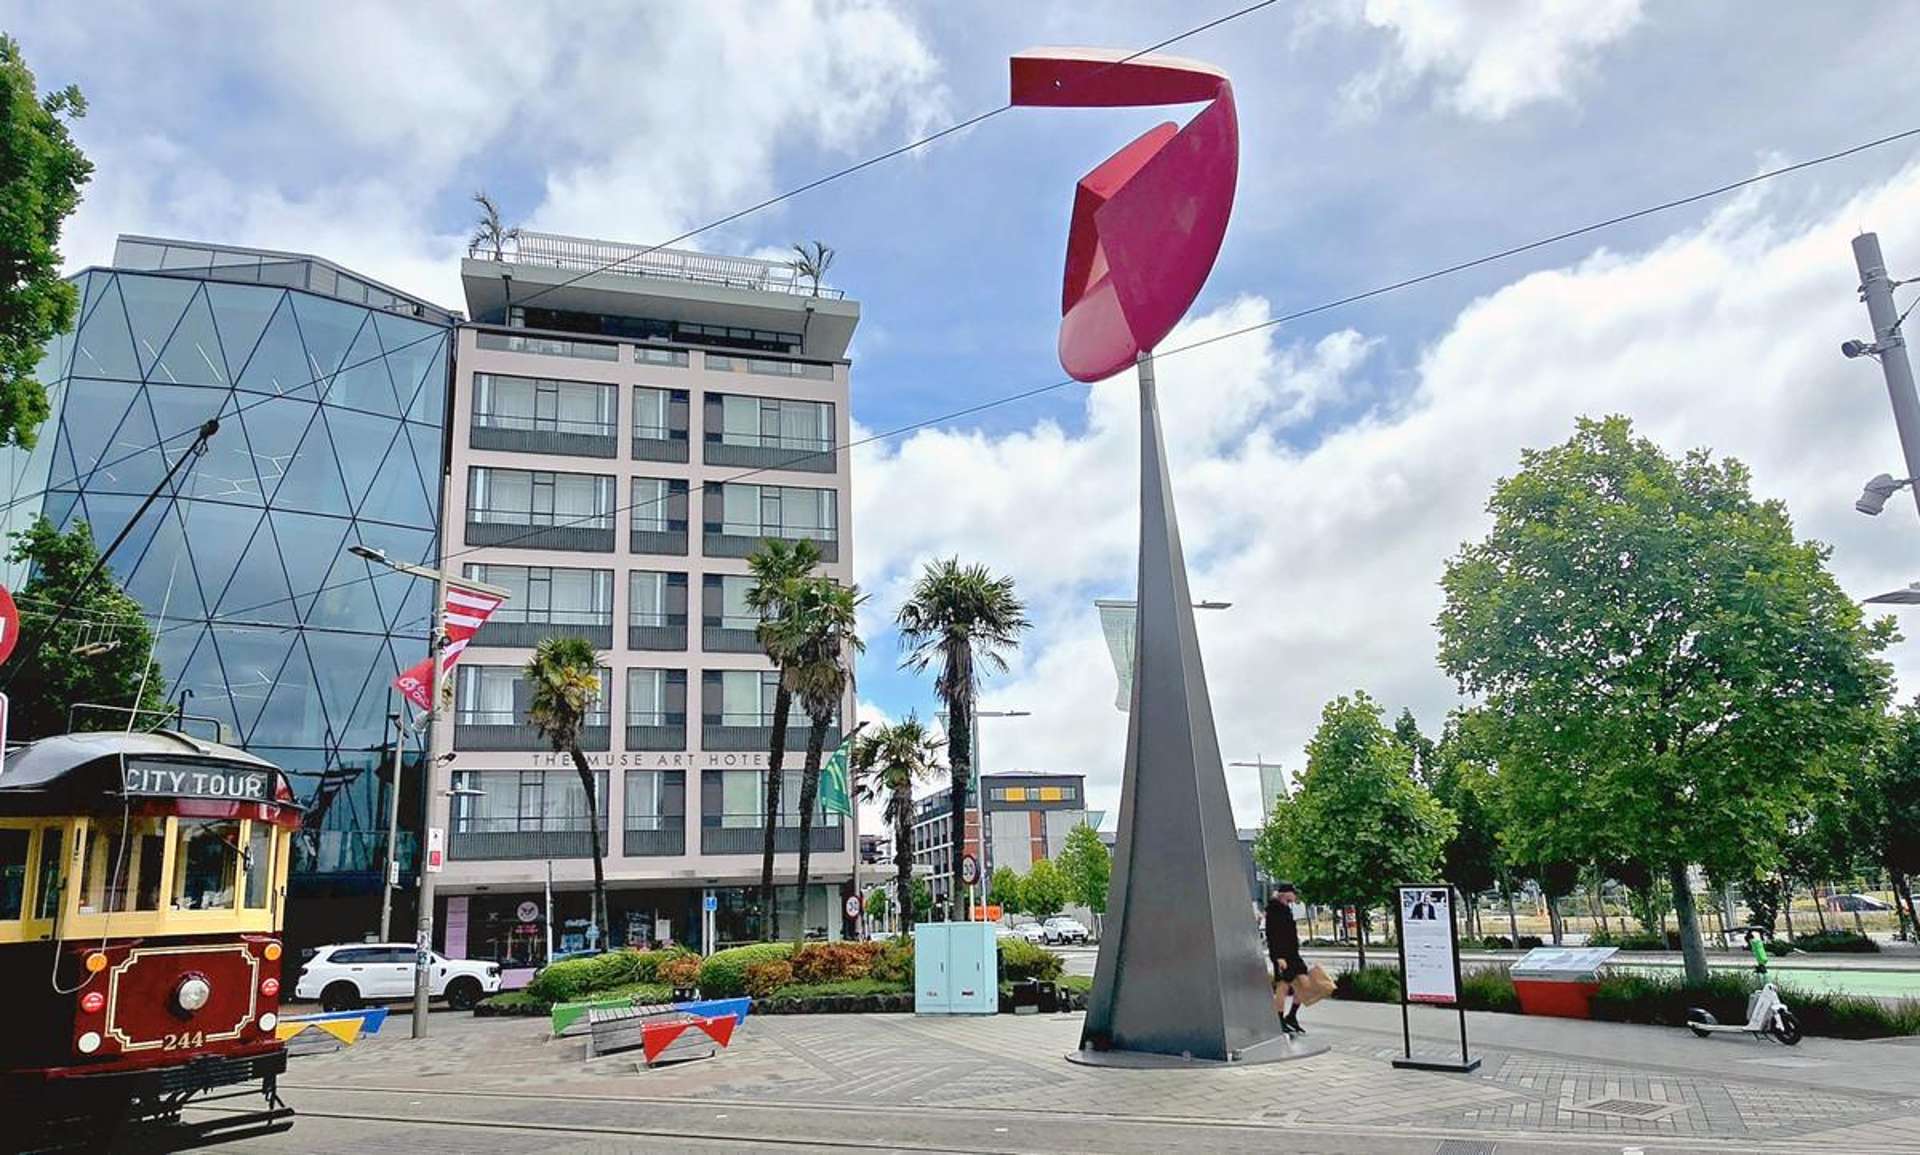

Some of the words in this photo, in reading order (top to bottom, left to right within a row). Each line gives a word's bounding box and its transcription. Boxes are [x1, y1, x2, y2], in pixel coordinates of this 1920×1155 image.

[532, 754, 570, 767] THE
[587, 753, 642, 767] MUSE
[657, 753, 695, 767] ART
[126, 768, 186, 793] CITY
[191, 772, 263, 798] TOUR
[163, 1030, 203, 1051] 244
